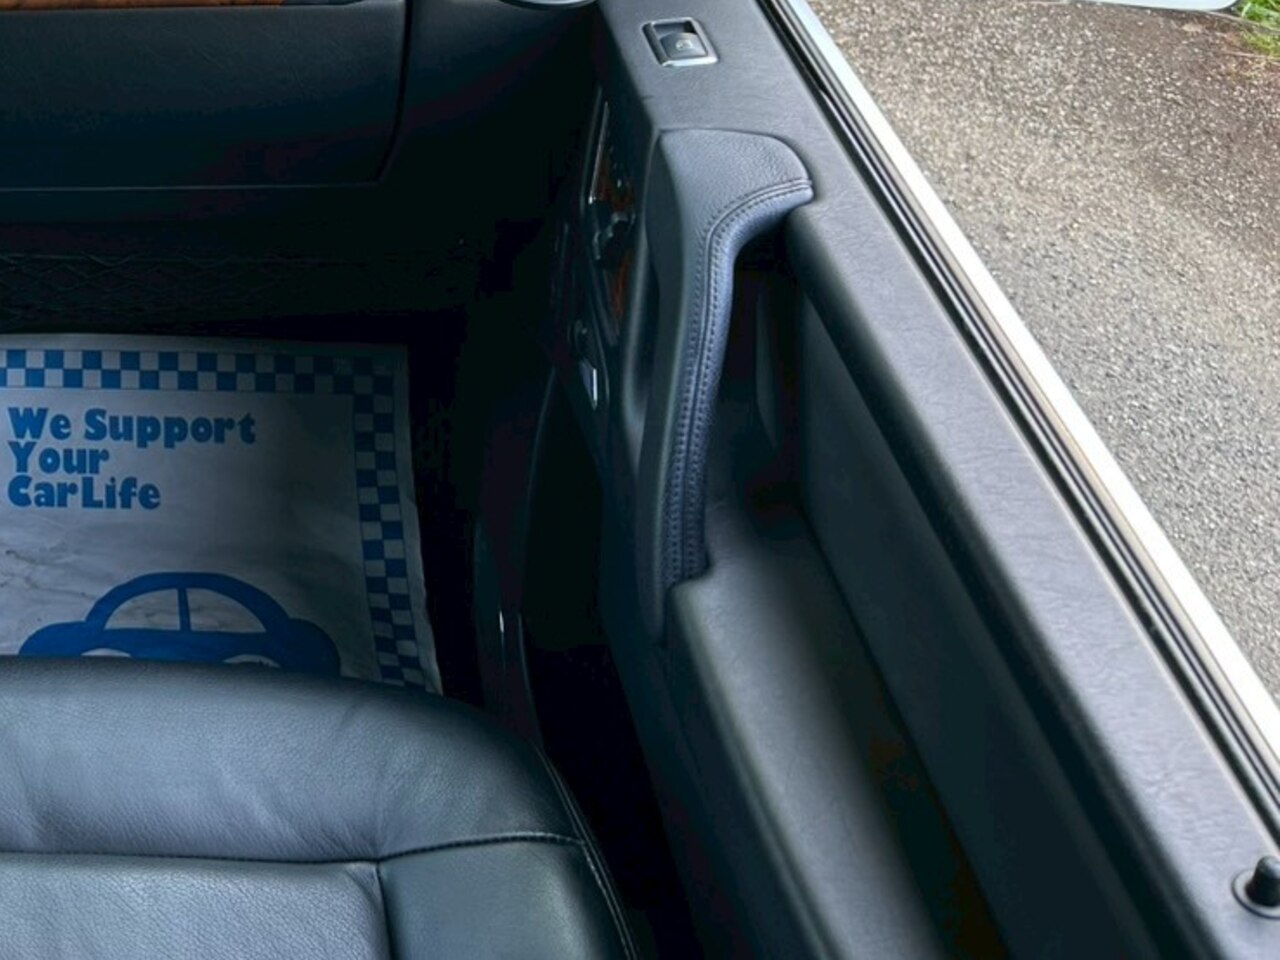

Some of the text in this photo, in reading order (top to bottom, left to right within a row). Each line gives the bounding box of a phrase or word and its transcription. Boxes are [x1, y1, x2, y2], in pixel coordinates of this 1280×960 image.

[7, 406, 257, 449] We Support
[7, 441, 110, 475] Your
